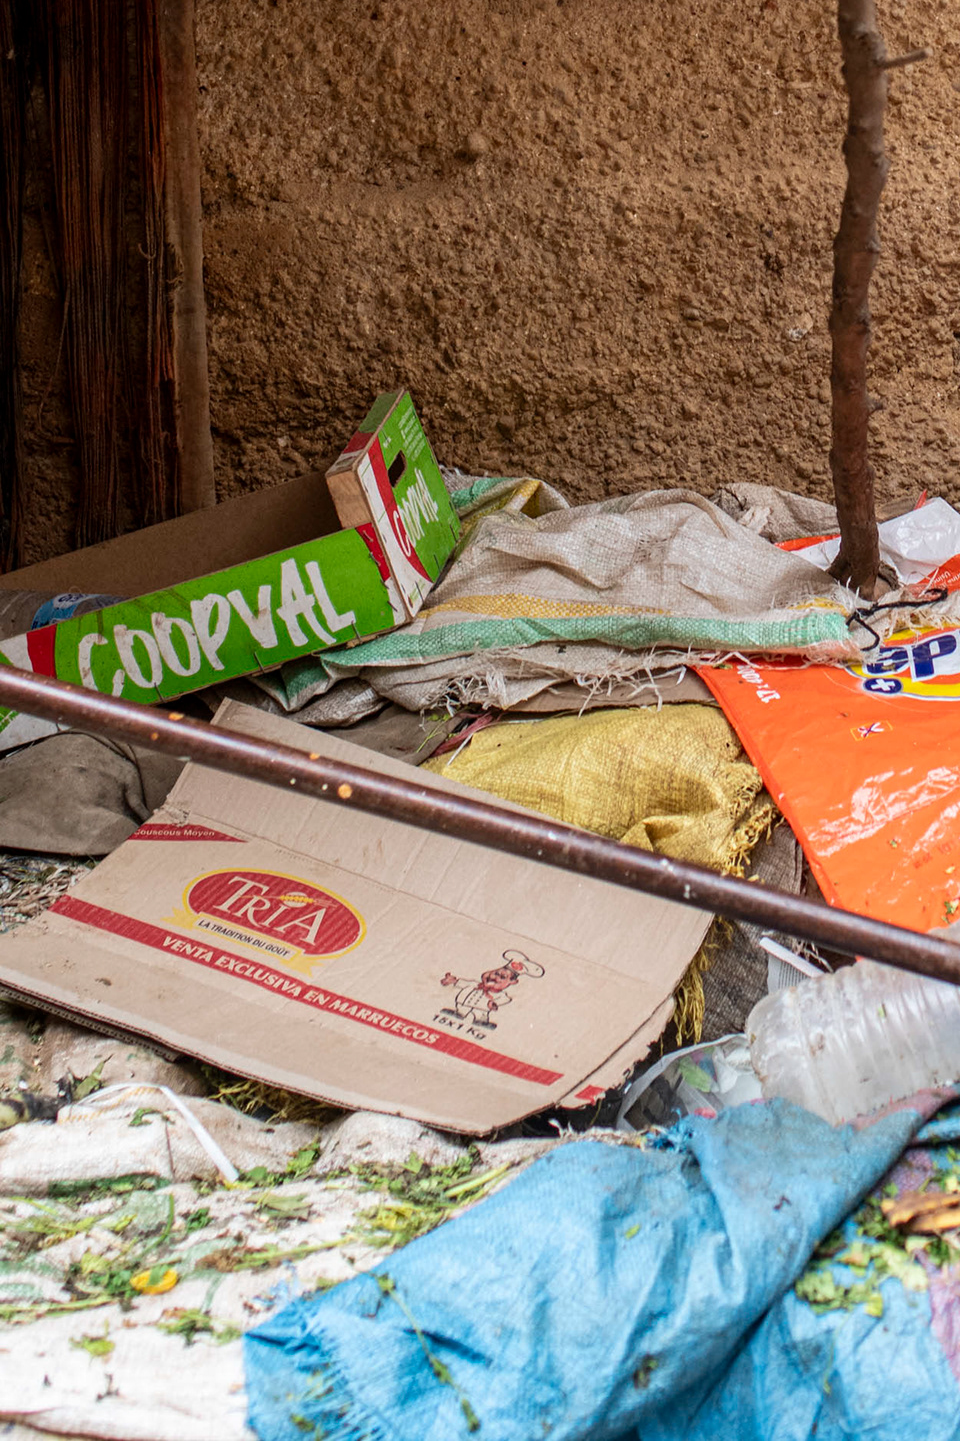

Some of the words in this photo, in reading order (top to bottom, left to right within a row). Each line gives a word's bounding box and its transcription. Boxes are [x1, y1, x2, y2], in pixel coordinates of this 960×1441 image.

[77, 558, 355, 698] COOPVAL
[183, 829, 216, 837] Moyen
[198, 919, 210, 930] LA
[209, 923, 253, 944] TRADITION
[252, 938, 267, 948] DU
[213, 875, 328, 946] TRIA
[162, 935, 214, 963] VENTA
[214, 955, 302, 997] EXCLUSIVA
[303, 990, 329, 1006] EN
[330, 999, 440, 1045] MARRUECOS
